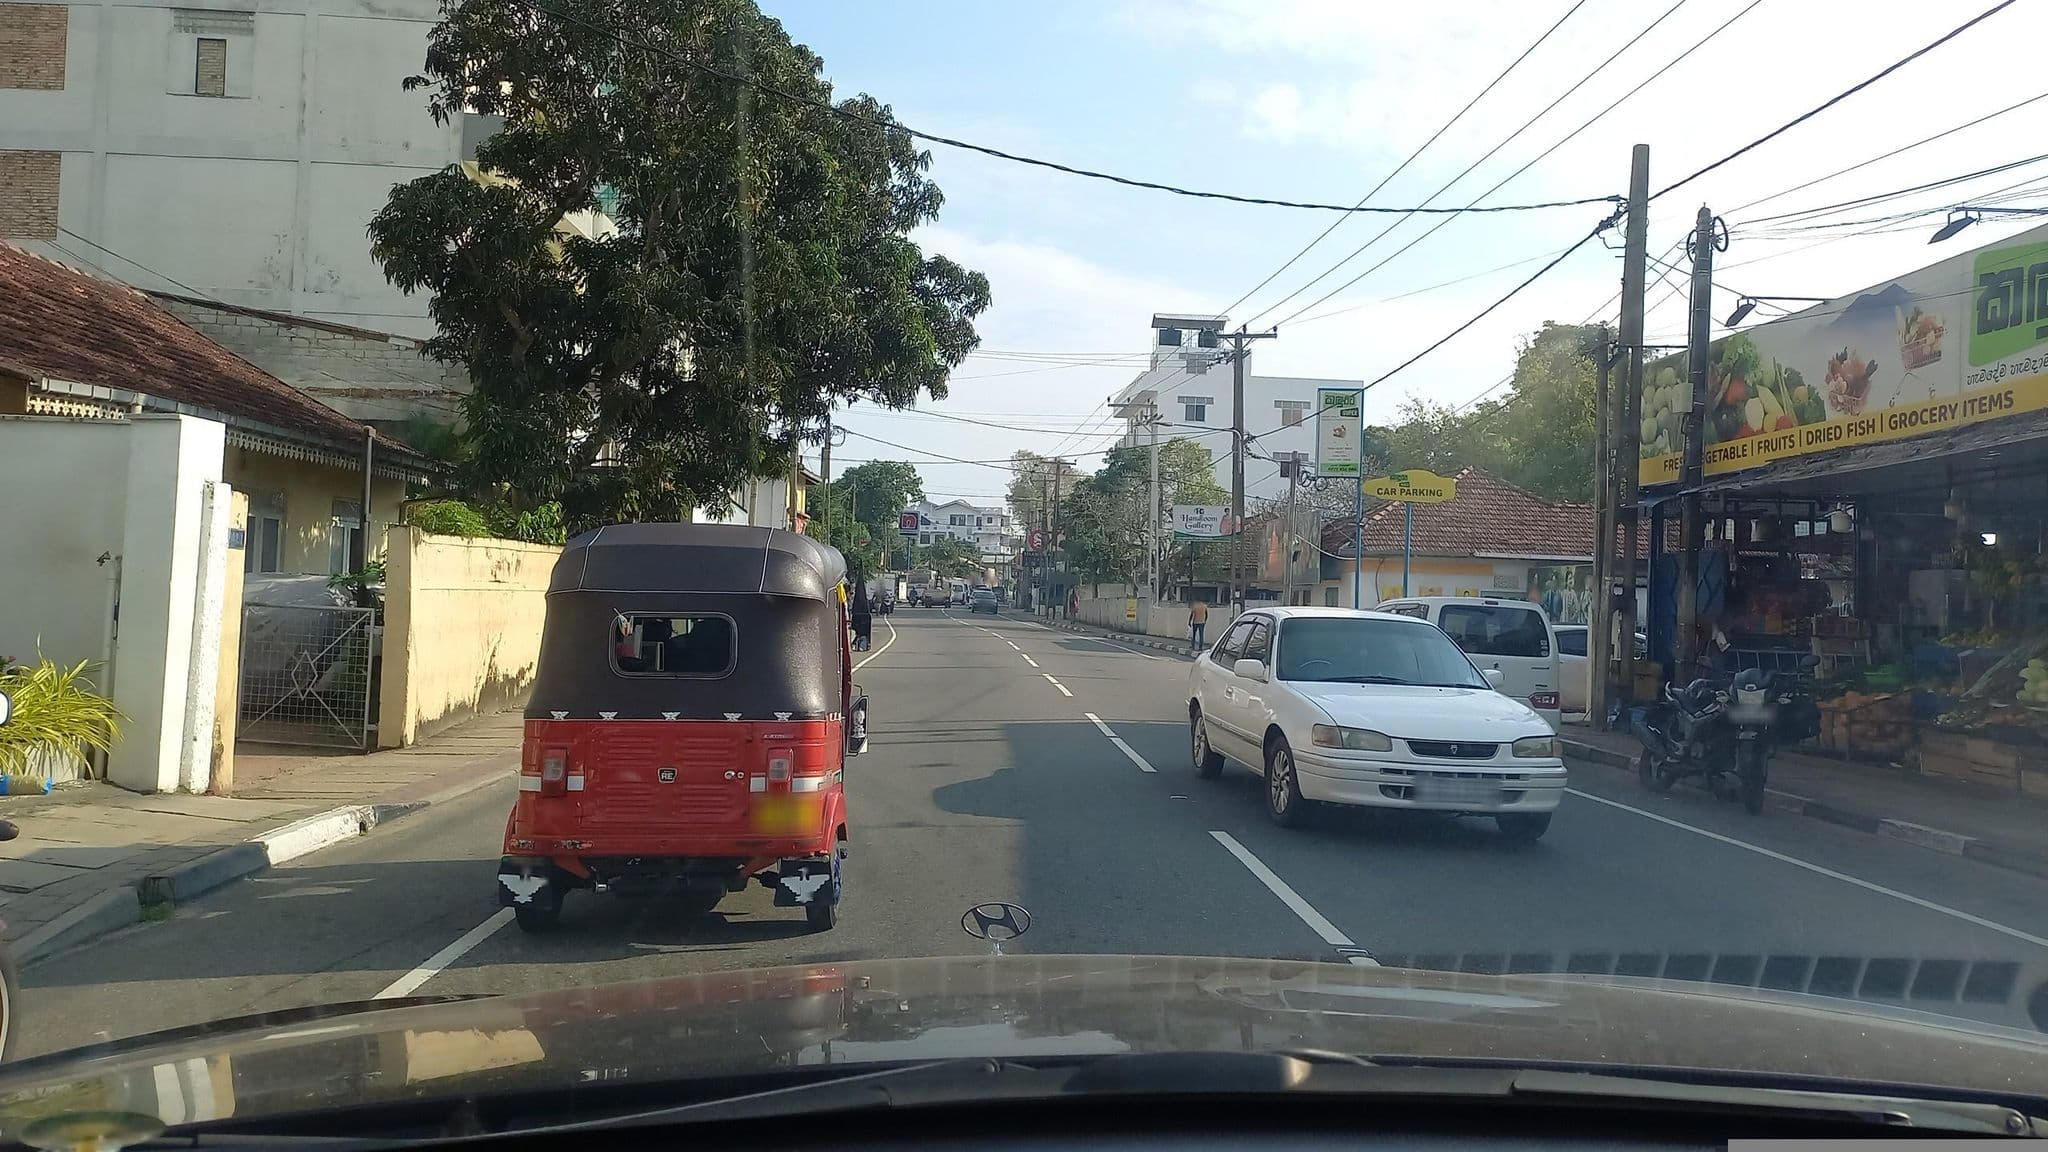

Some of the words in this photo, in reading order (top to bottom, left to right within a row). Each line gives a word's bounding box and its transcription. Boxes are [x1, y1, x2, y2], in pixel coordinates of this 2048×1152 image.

[1663, 456, 1684, 472] FRES
[1705, 444, 1748, 465] GETABLE
[1757, 434, 1795, 455] FRUITS
[1806, 424, 1842, 446] DRIED
[1847, 417, 1876, 438] FISH
[1888, 403, 1958, 431] GROCERY
[1963, 390, 2014, 418] ITEMS
[1376, 487, 1397, 496] CAR
[1400, 488, 1443, 497] PARKING
